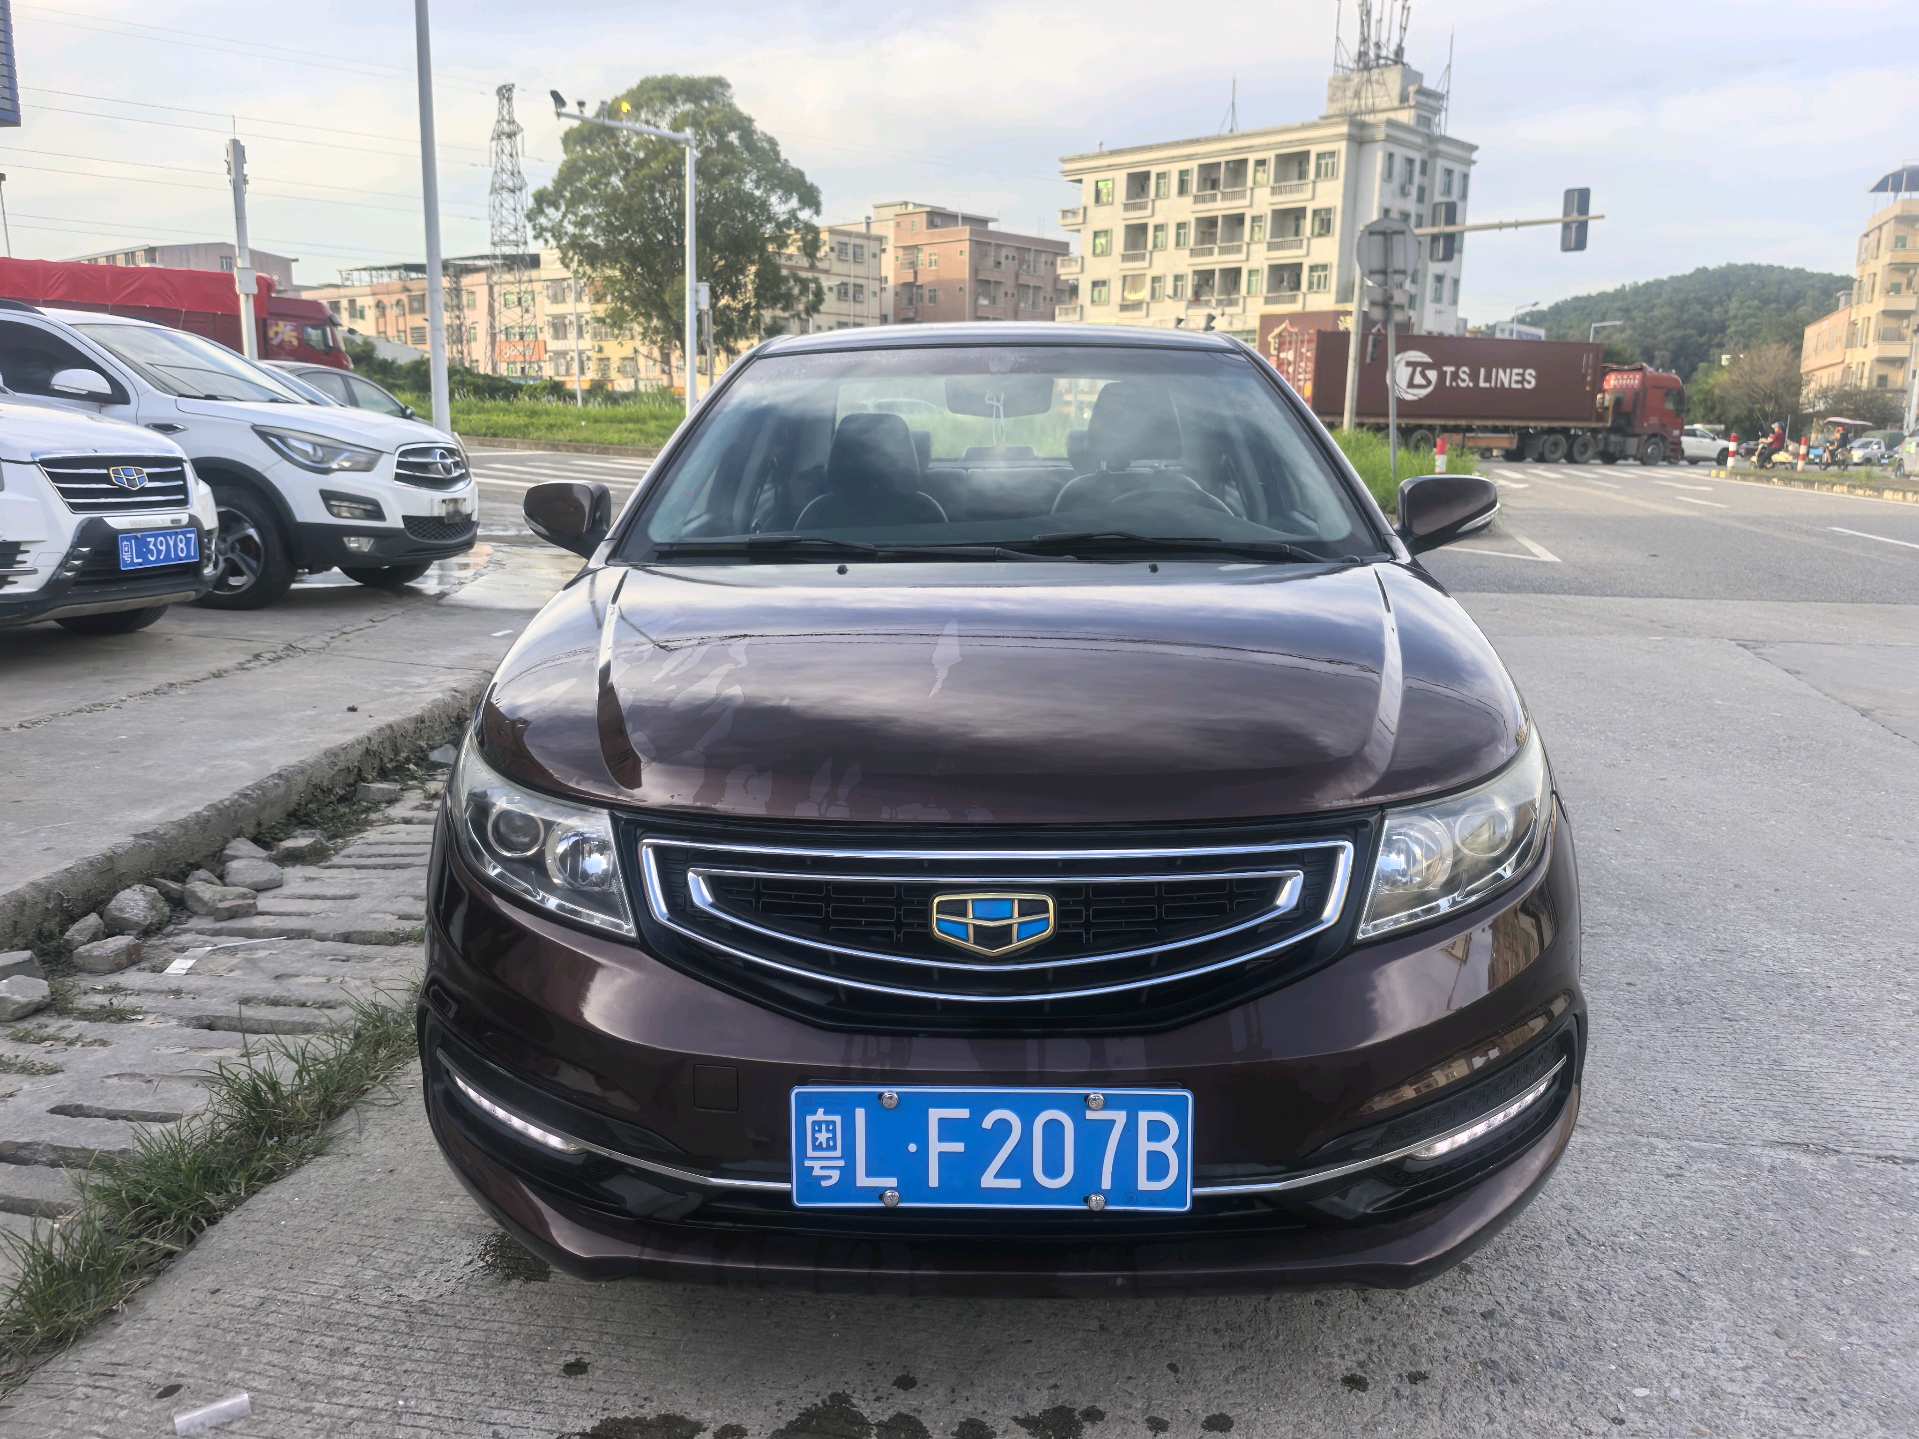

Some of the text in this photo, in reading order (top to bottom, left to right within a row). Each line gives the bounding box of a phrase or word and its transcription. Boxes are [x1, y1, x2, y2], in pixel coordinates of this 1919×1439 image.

[1442, 365, 1474, 388] T.S.
[1478, 366, 1537, 390] LINES
[804, 1107, 1180, 1191] 粤L·F207B
